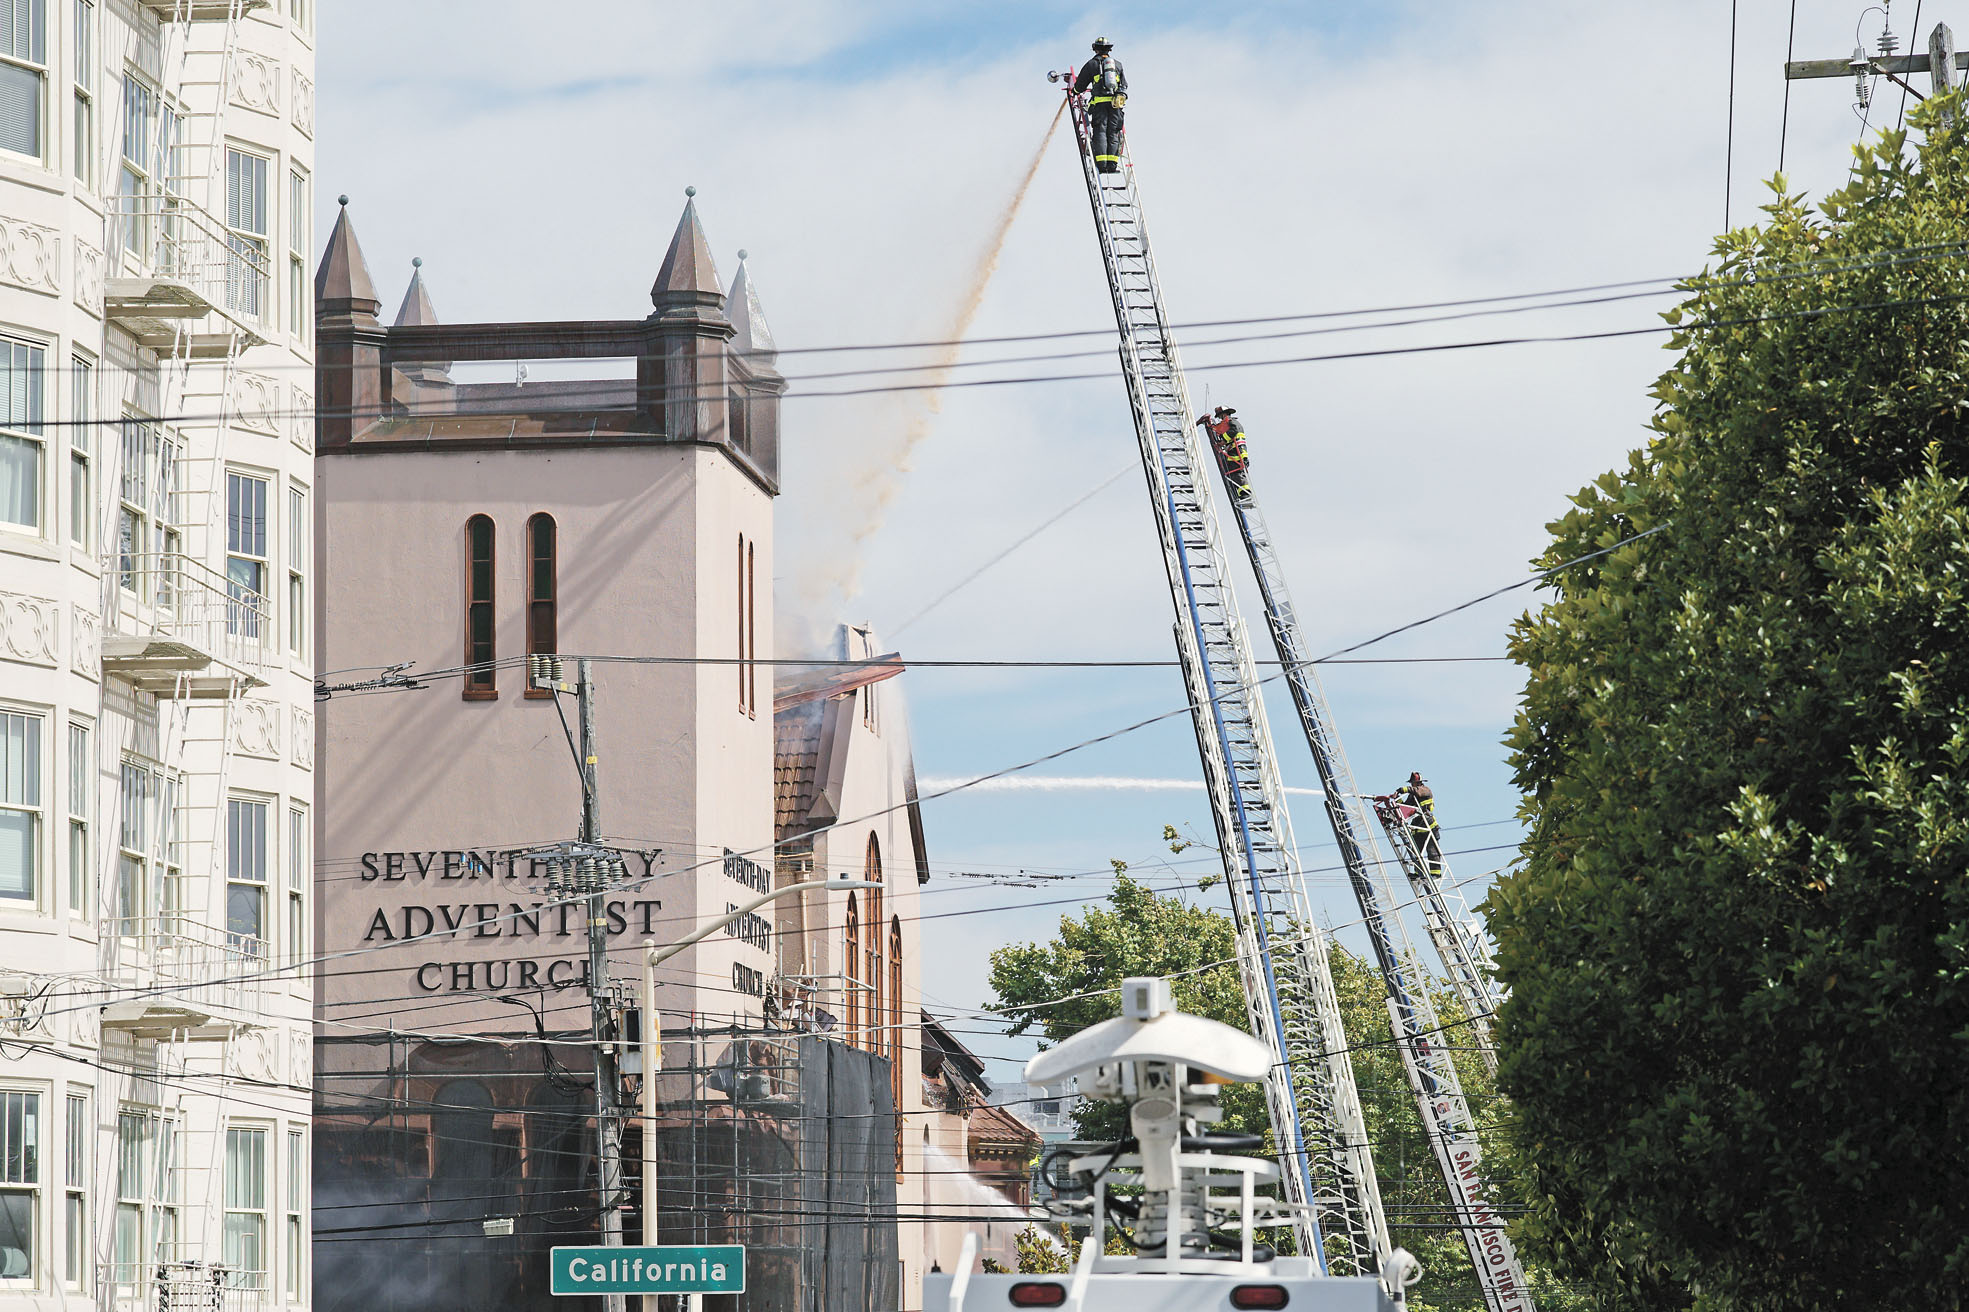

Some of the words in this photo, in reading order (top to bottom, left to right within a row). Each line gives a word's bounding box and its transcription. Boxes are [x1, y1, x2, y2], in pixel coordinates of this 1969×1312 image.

[363, 900, 662, 941] ADVENTST
[732, 960, 763, 999] CHURCH
[1455, 1150, 1477, 1181] SAN
[1494, 1268, 1519, 1303] FIRE
[568, 1257, 727, 1283] California
